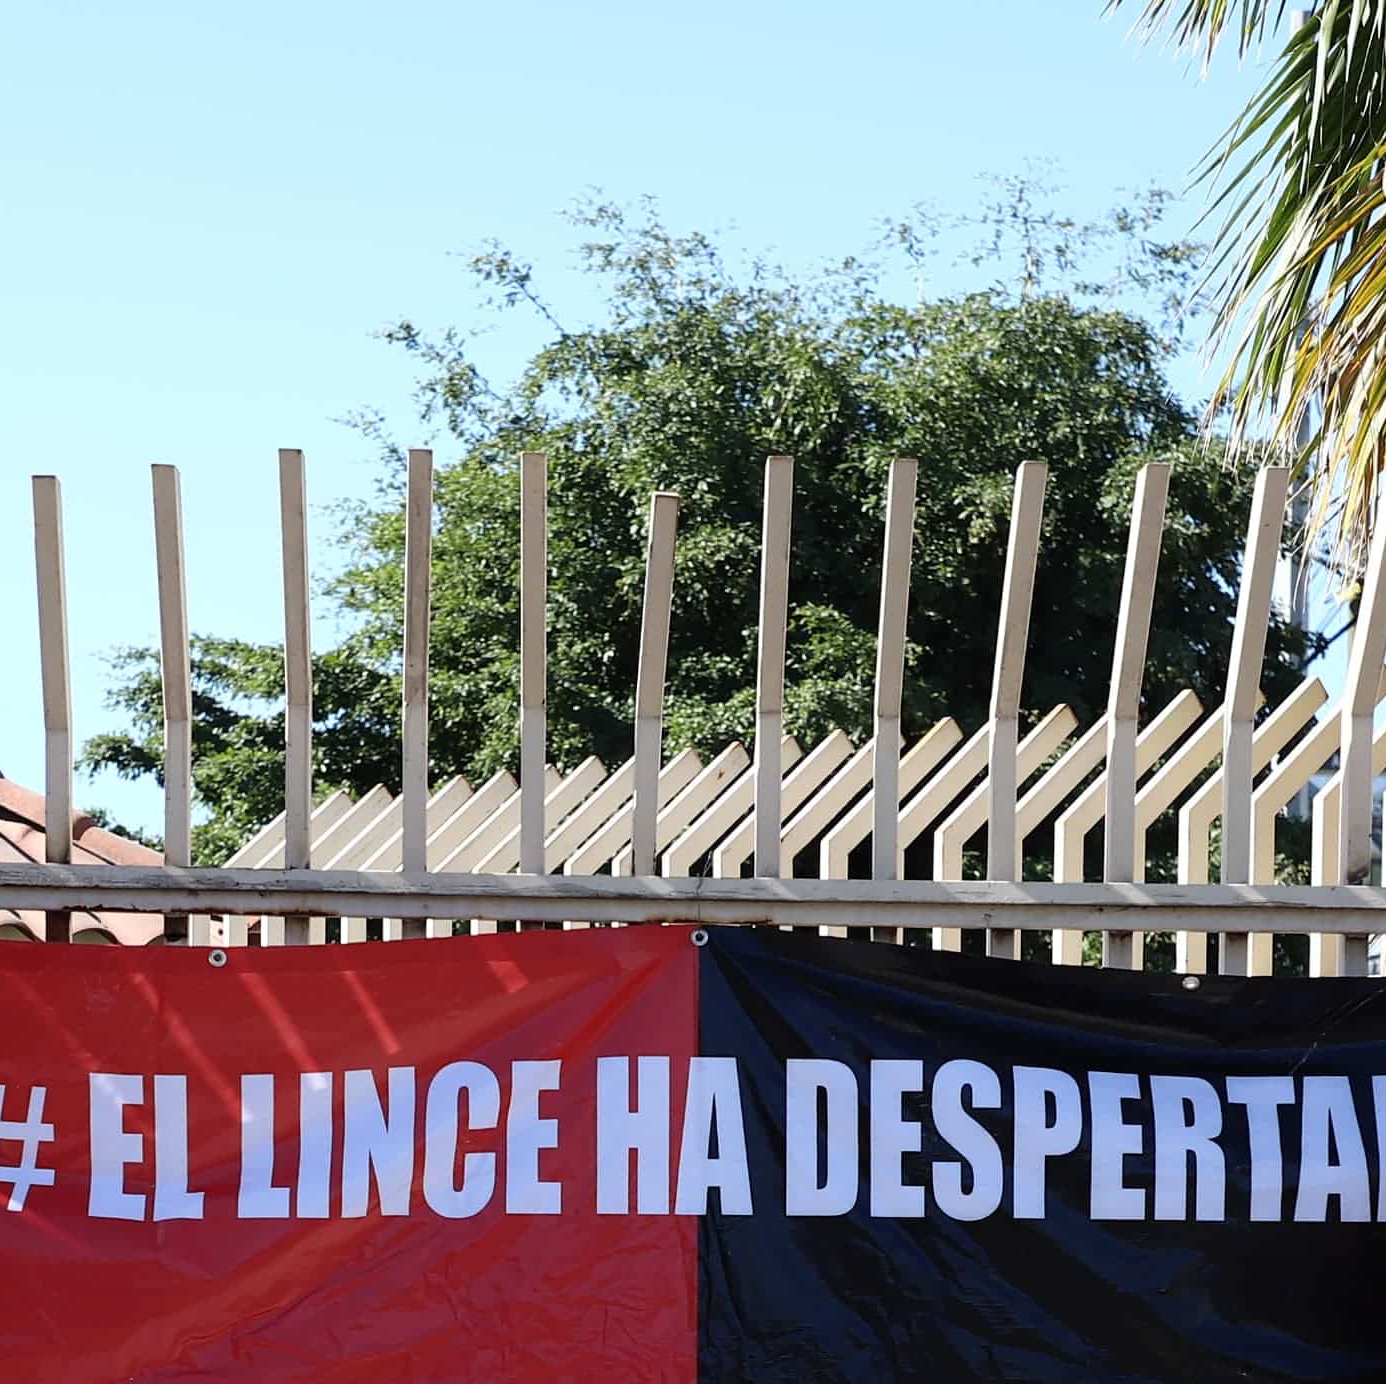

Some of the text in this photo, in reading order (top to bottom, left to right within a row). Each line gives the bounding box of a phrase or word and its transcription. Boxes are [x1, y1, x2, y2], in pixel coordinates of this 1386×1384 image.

[88, 1072, 205, 1222] EL
[237, 1059, 562, 1219] LINCE
[596, 1055, 754, 1217] HA
